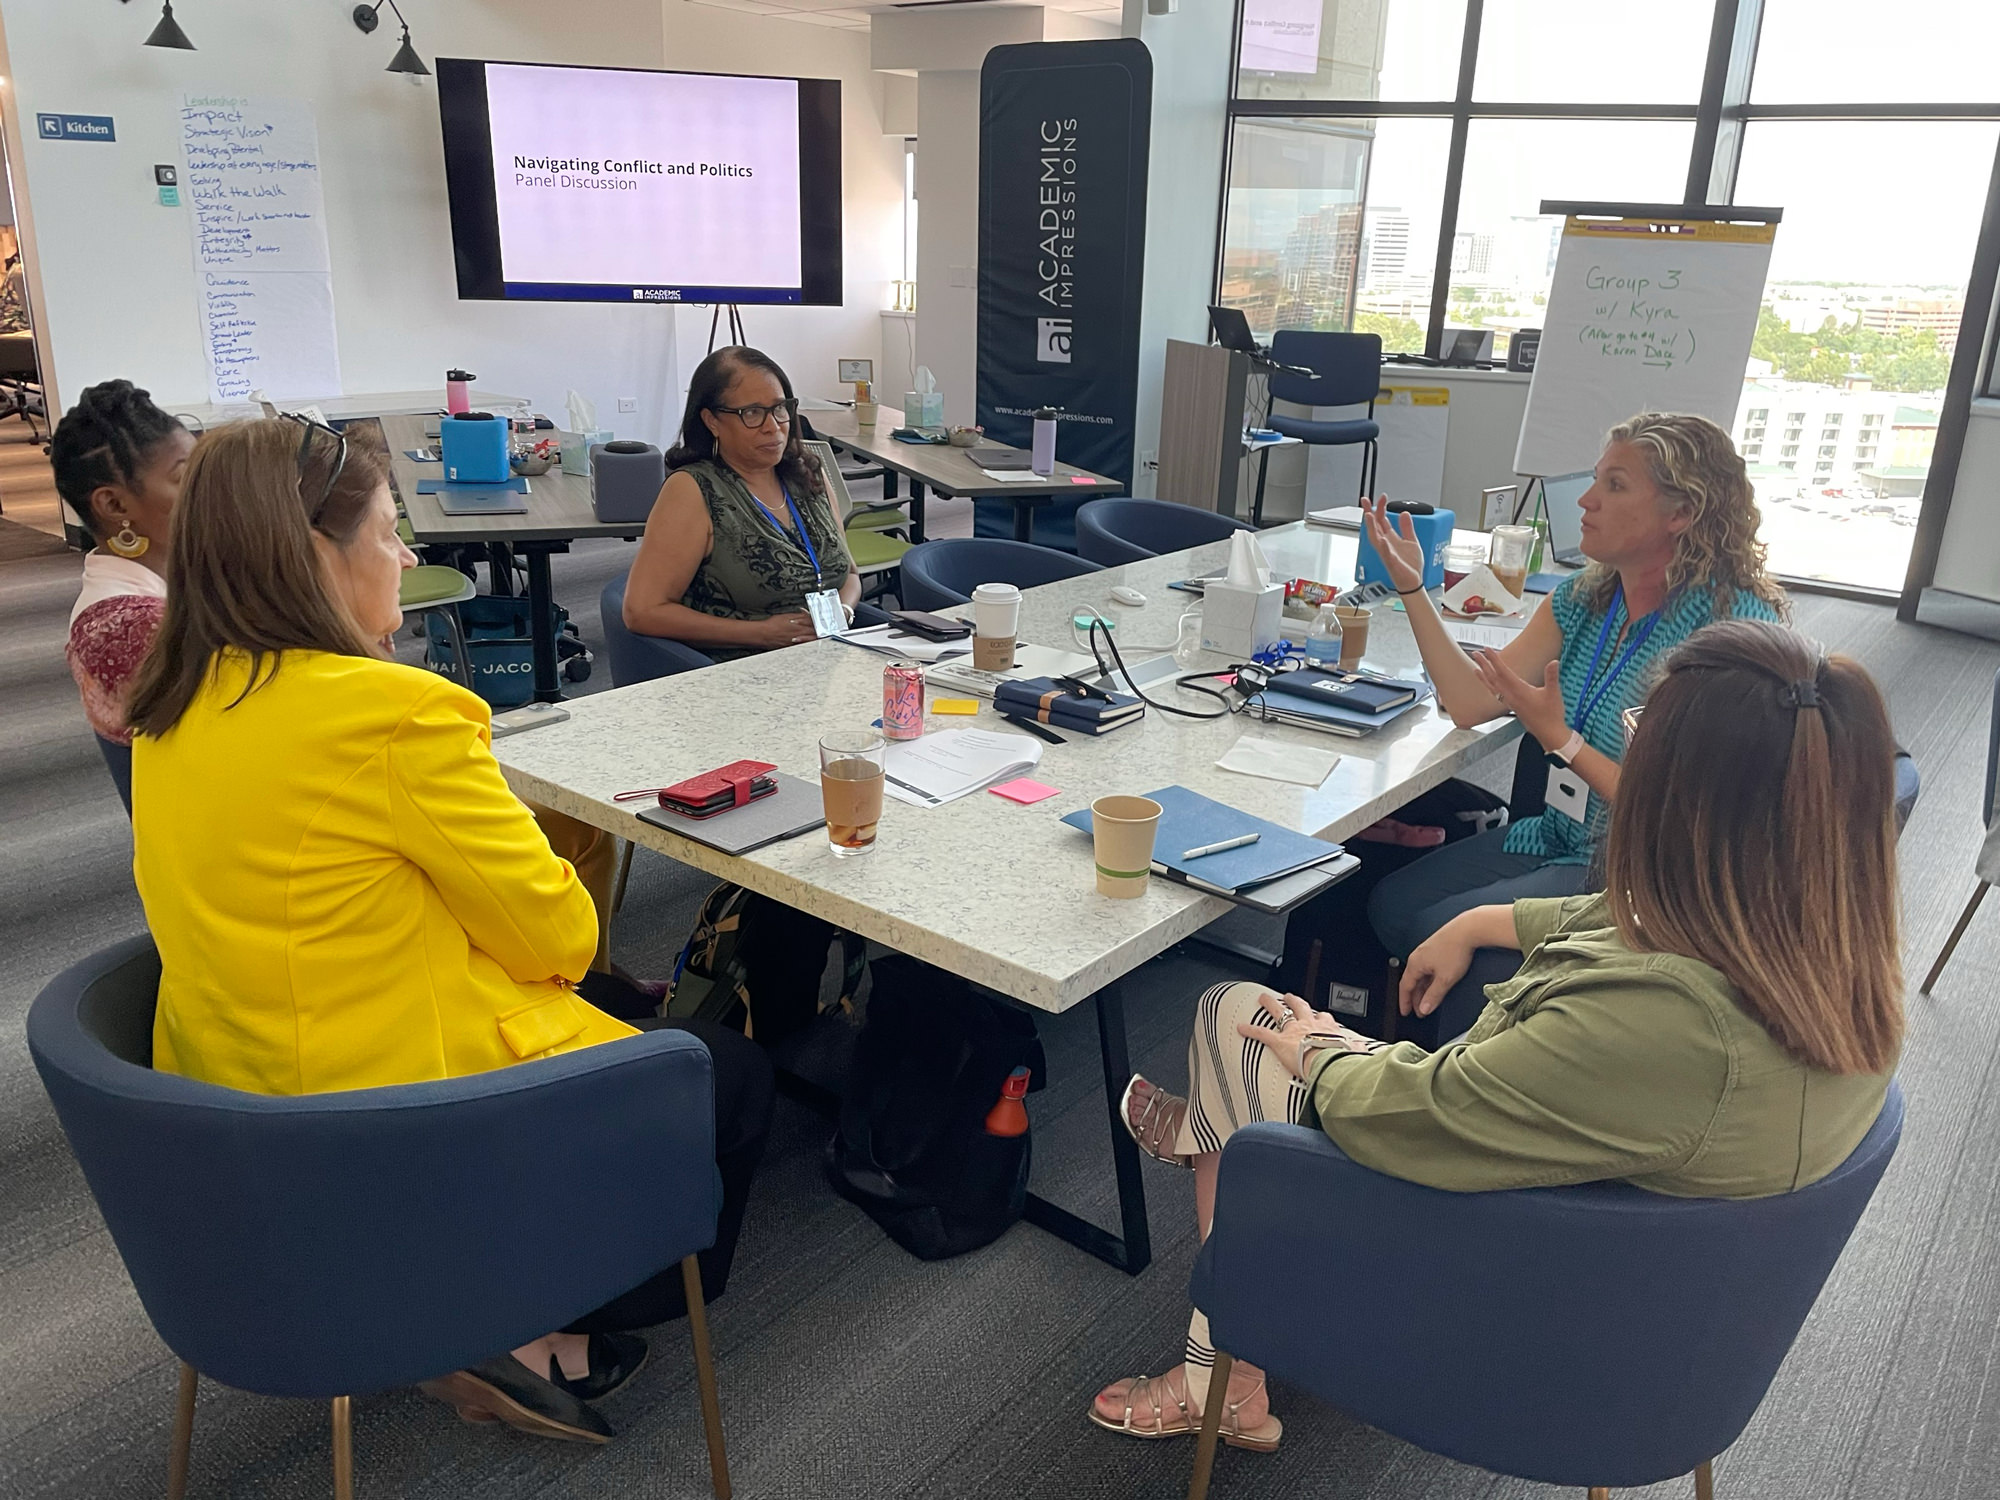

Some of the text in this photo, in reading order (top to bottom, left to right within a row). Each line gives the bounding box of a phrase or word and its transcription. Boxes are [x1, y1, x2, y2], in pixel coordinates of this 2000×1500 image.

[181, 108, 243, 125] Impact
[66, 122, 109, 134] Kitchen
[514, 156, 753, 178] Navigating Conflict and Politics
[515, 173, 637, 190] Panel Discussion
[192, 183, 287, 200] Walk the Walk
[195, 199, 235, 213] Service
[1038, 119, 1062, 306] ACADEMIC
[1059, 117, 1078, 308] IMPRESSIONS
[1586, 265, 1682, 297] Group 3
[1629, 300, 1680, 326] Kyra
[994, 406, 1114, 425] www.acadepressions.com
